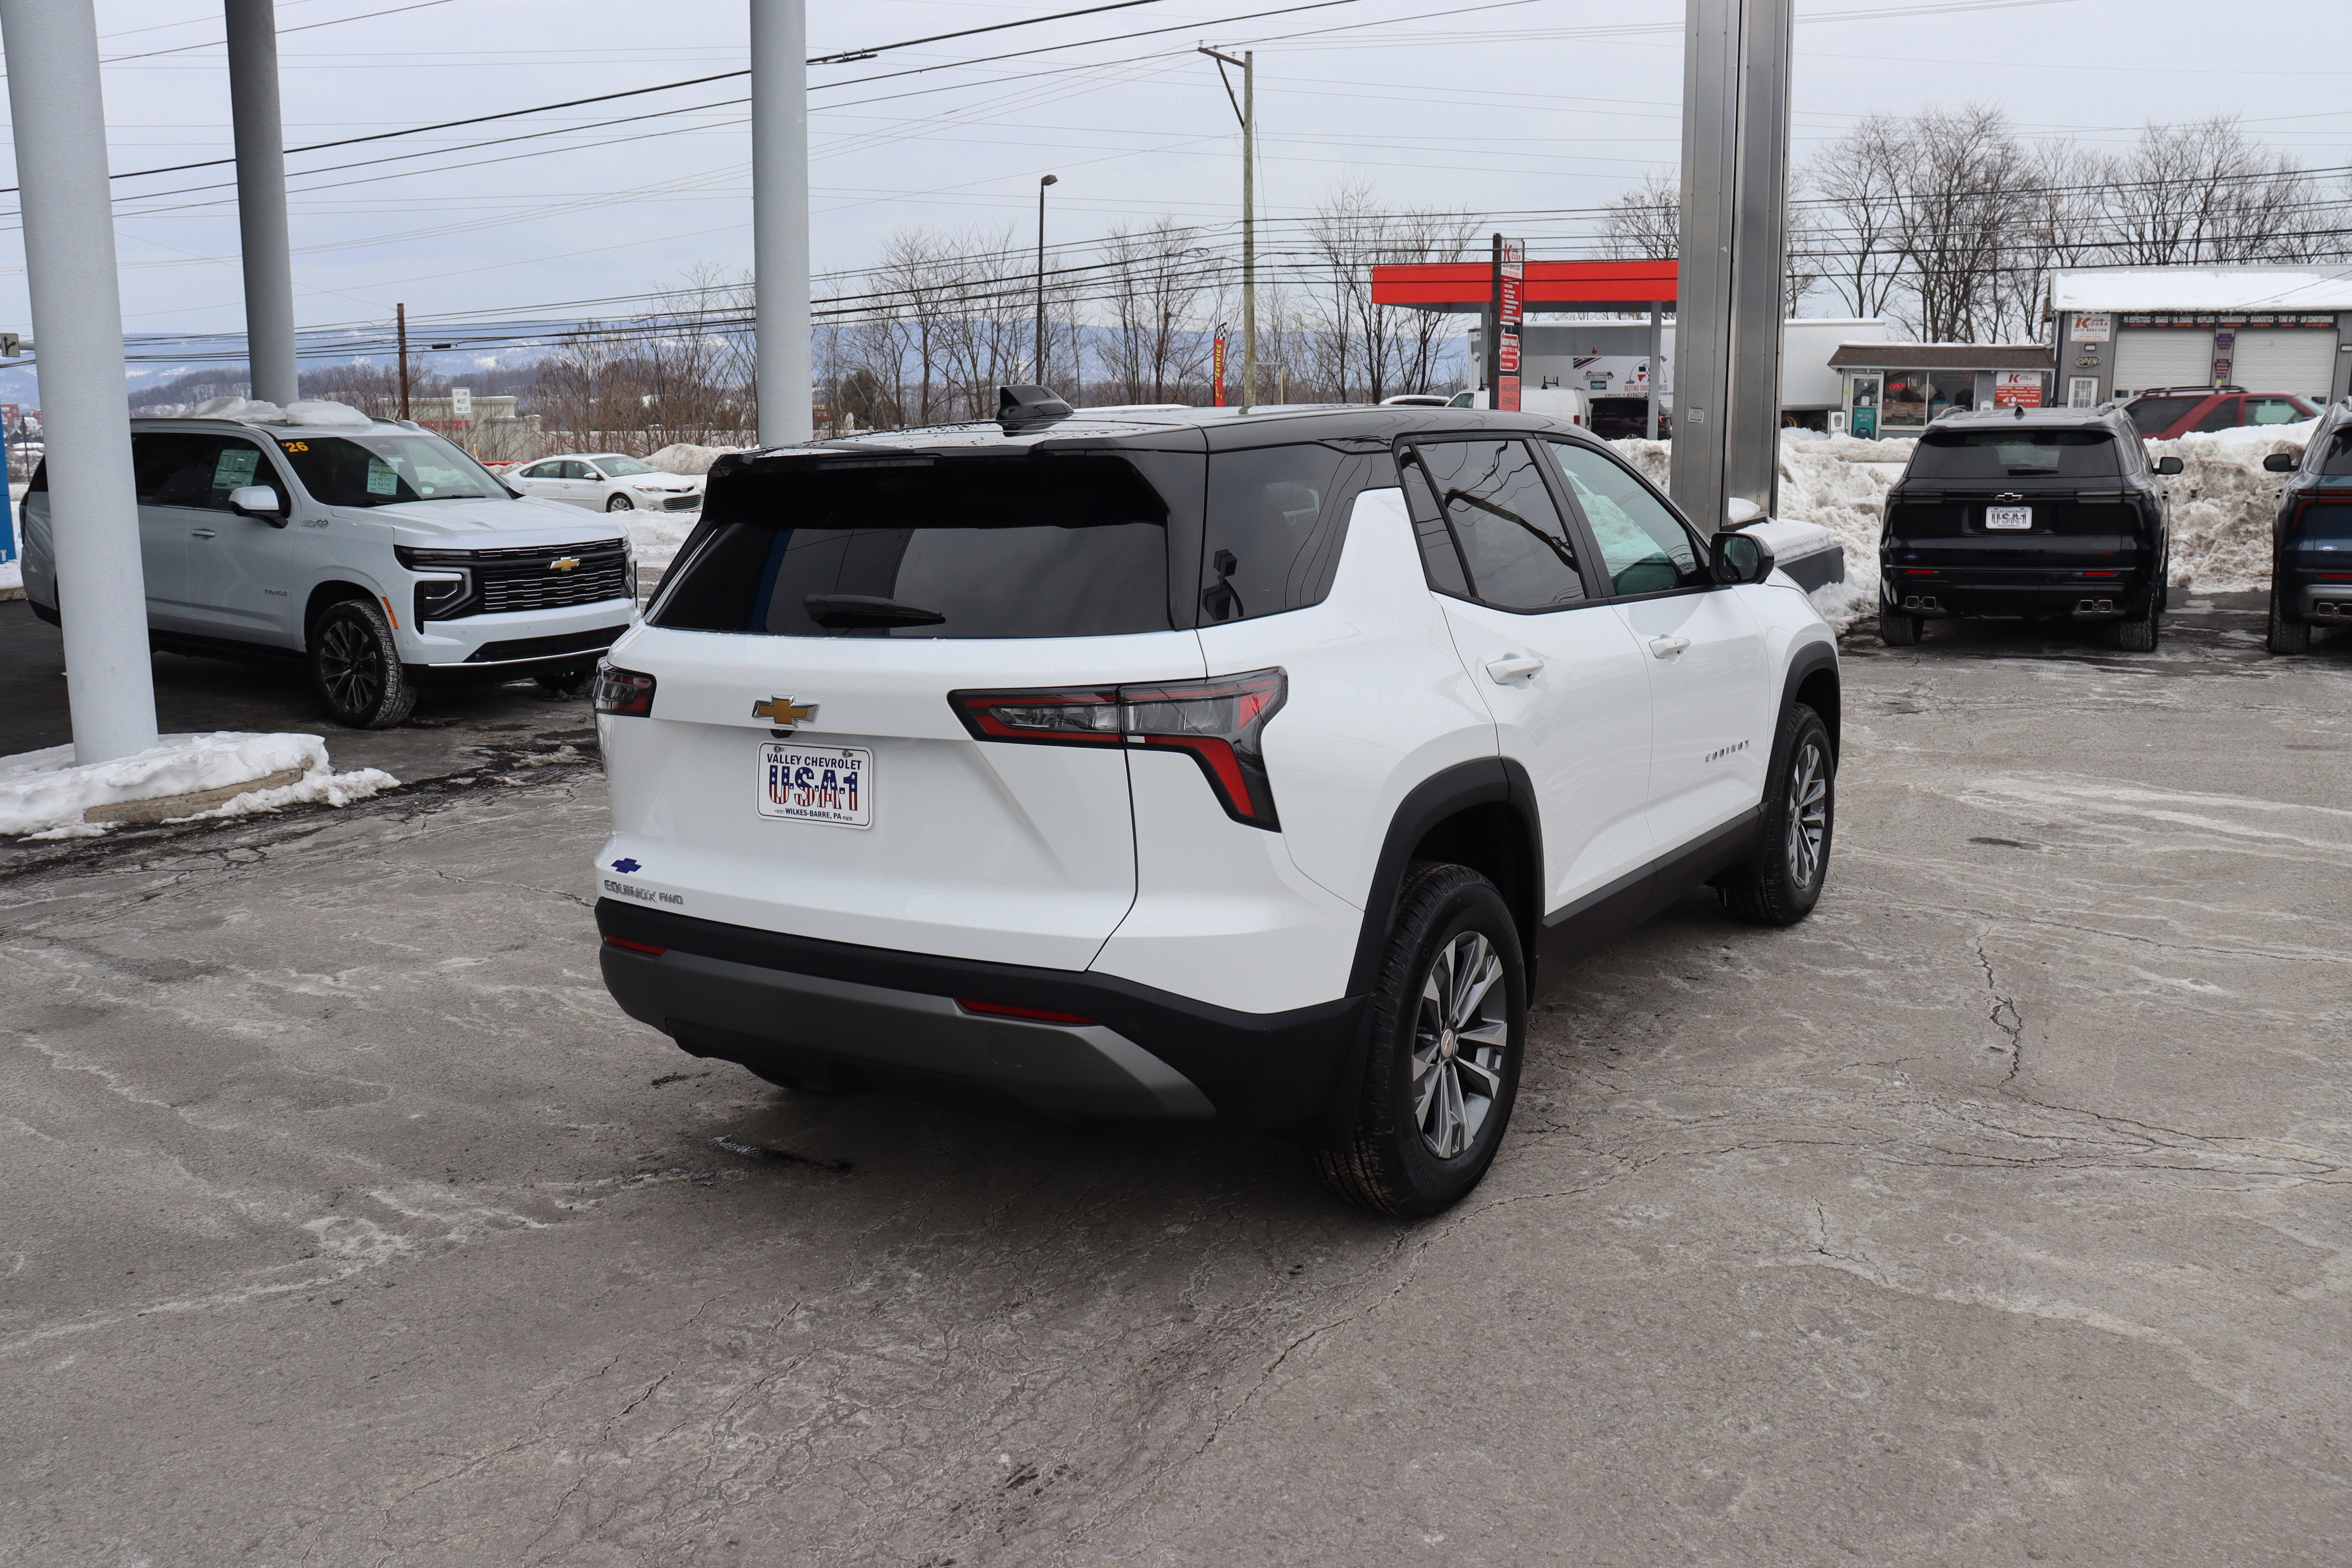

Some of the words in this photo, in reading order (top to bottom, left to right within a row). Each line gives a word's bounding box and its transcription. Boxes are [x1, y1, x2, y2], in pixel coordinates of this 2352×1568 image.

[2075, 317, 2108, 328] KIDDER
[281, 442, 309, 452] '26
[1705, 739, 1750, 763] EQUINOX
[767, 753, 802, 765] VALLEY
[804, 756, 862, 770] CHEVROLET
[785, 808, 832, 820] WILKES-BARRE,
[604, 880, 657, 903] EQUINOX
[659, 892, 684, 905] AWD
